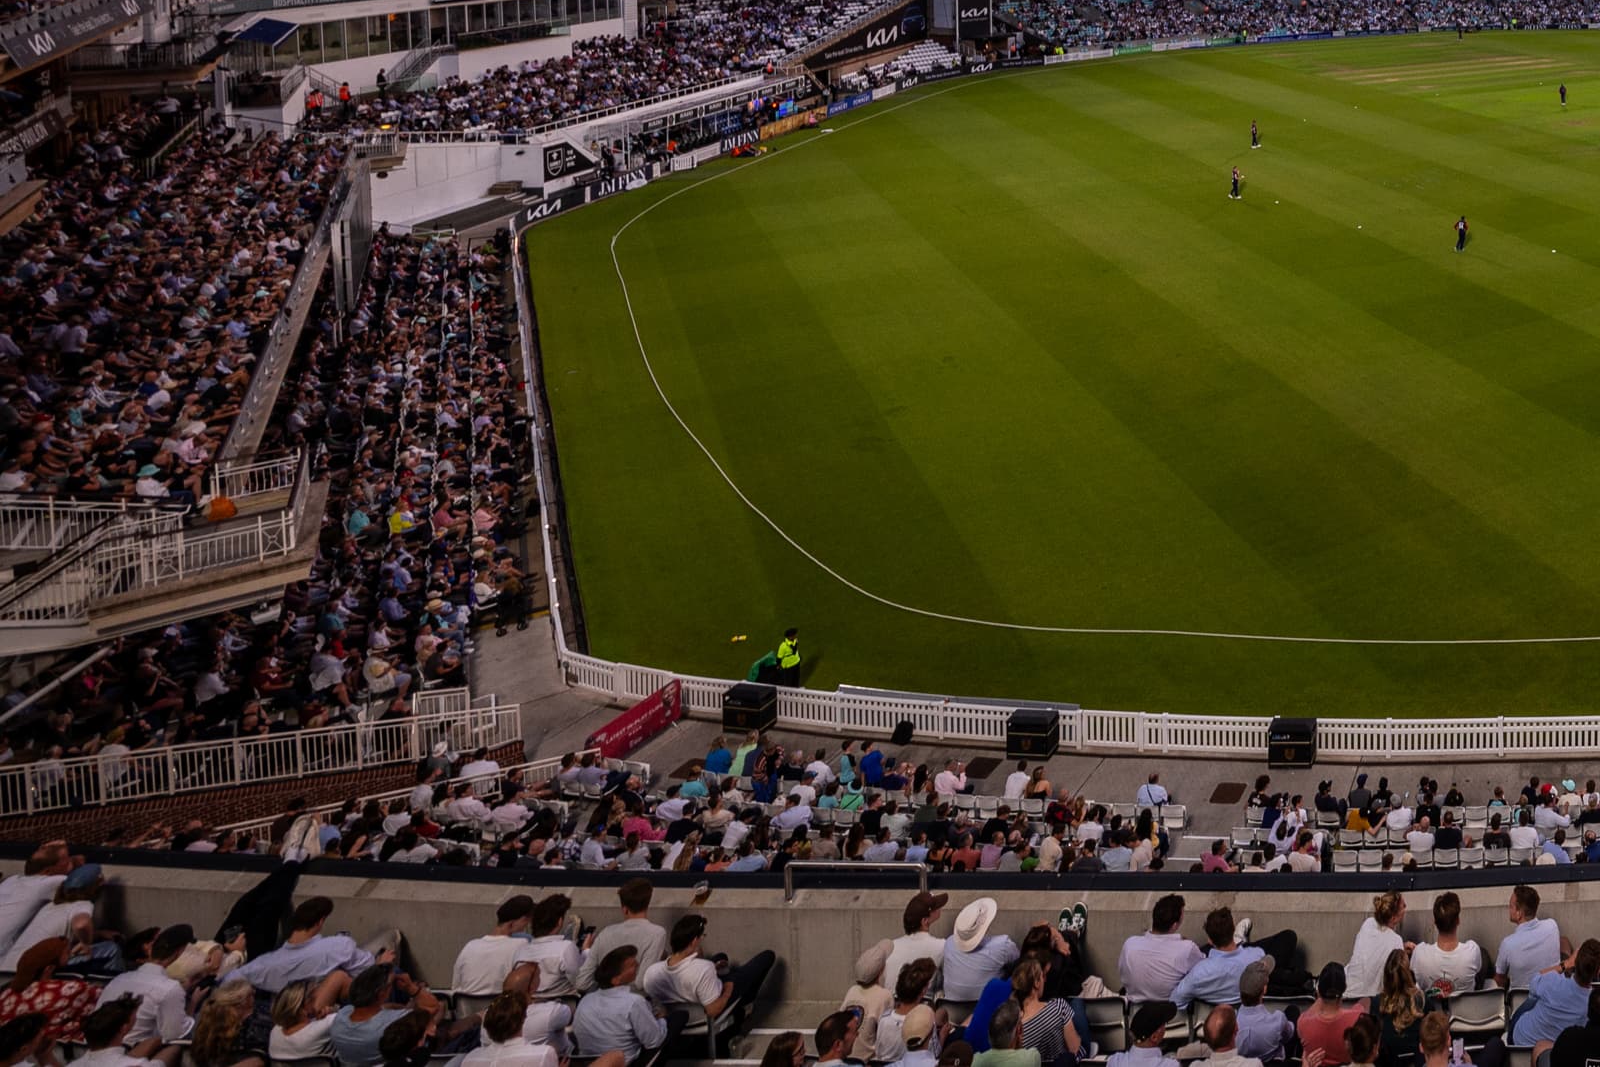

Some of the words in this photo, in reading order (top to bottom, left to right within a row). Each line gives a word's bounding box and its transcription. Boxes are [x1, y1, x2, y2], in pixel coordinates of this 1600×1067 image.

[723, 136, 737, 152] JM
[738, 129, 760, 148] FINN
[598, 177, 616, 197] JM
[617, 167, 647, 190] FINN
